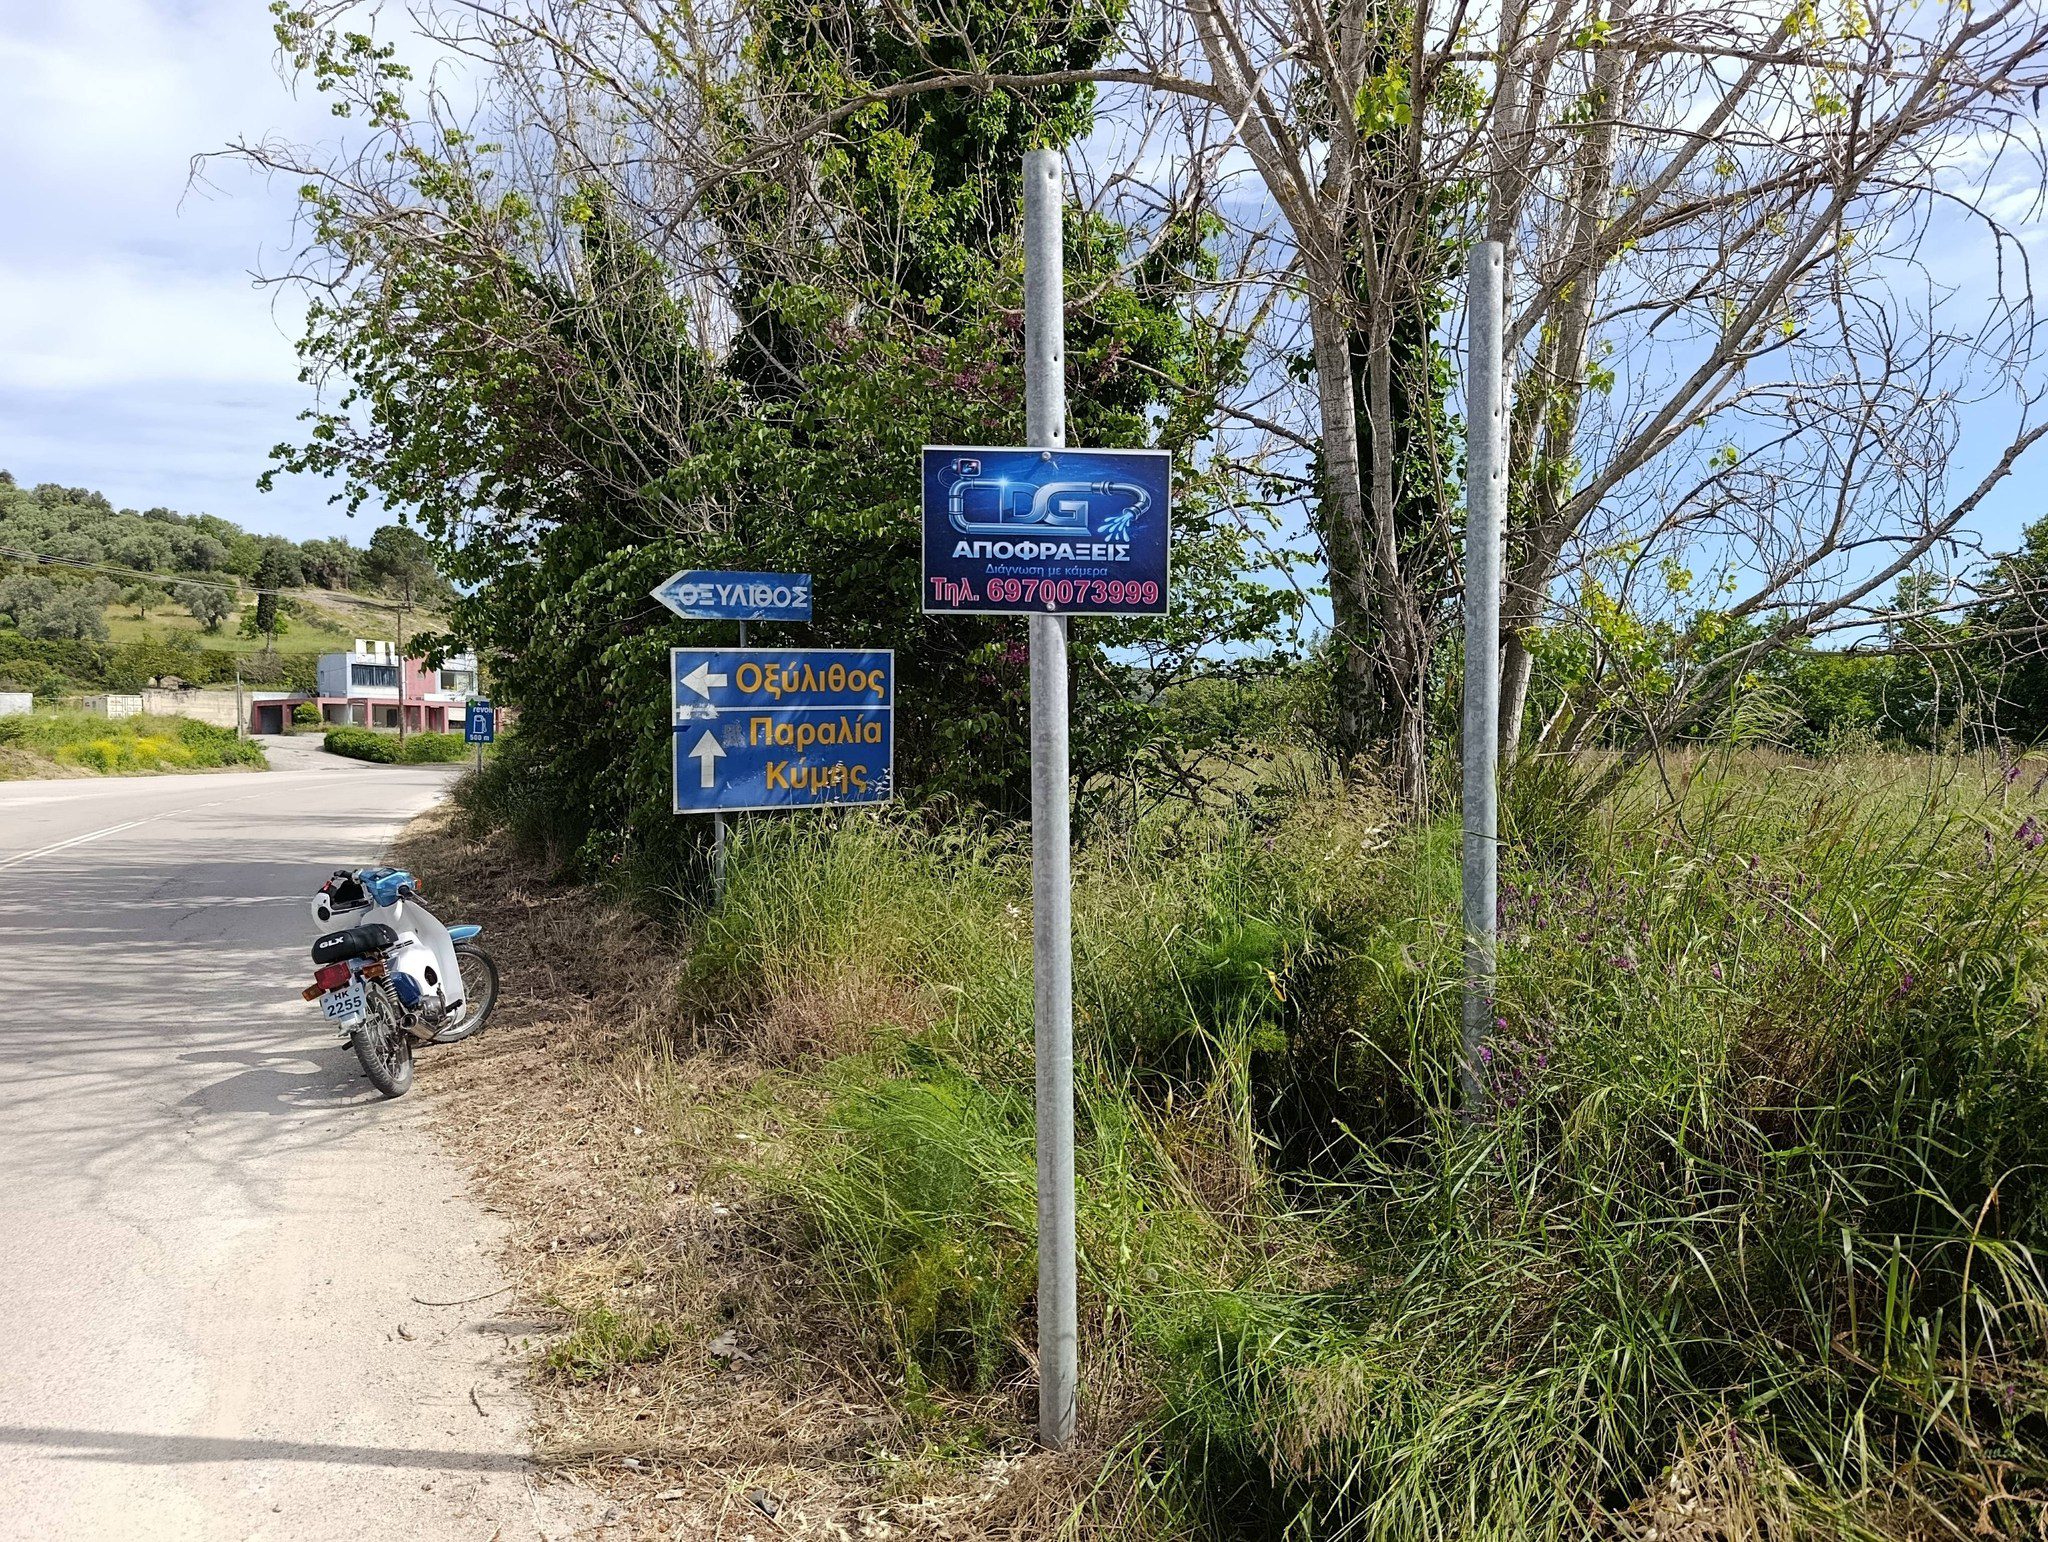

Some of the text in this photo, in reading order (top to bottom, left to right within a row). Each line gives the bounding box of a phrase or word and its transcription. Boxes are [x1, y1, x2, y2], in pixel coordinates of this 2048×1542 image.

[952, 540, 1131, 562] ΑΠΟΦΡΑΞΕΙΣ
[985, 563, 1108, 578] Διάγνωση με κάμερα
[931, 577, 1159, 607] Τηλ. 6970073999
[736, 661, 885, 700] Οξύλιθος
[750, 714, 882, 752] Παραλία
[766, 756, 868, 796] Κύμης
[319, 936, 344, 949] GLX
[327, 996, 362, 1018] 2255
